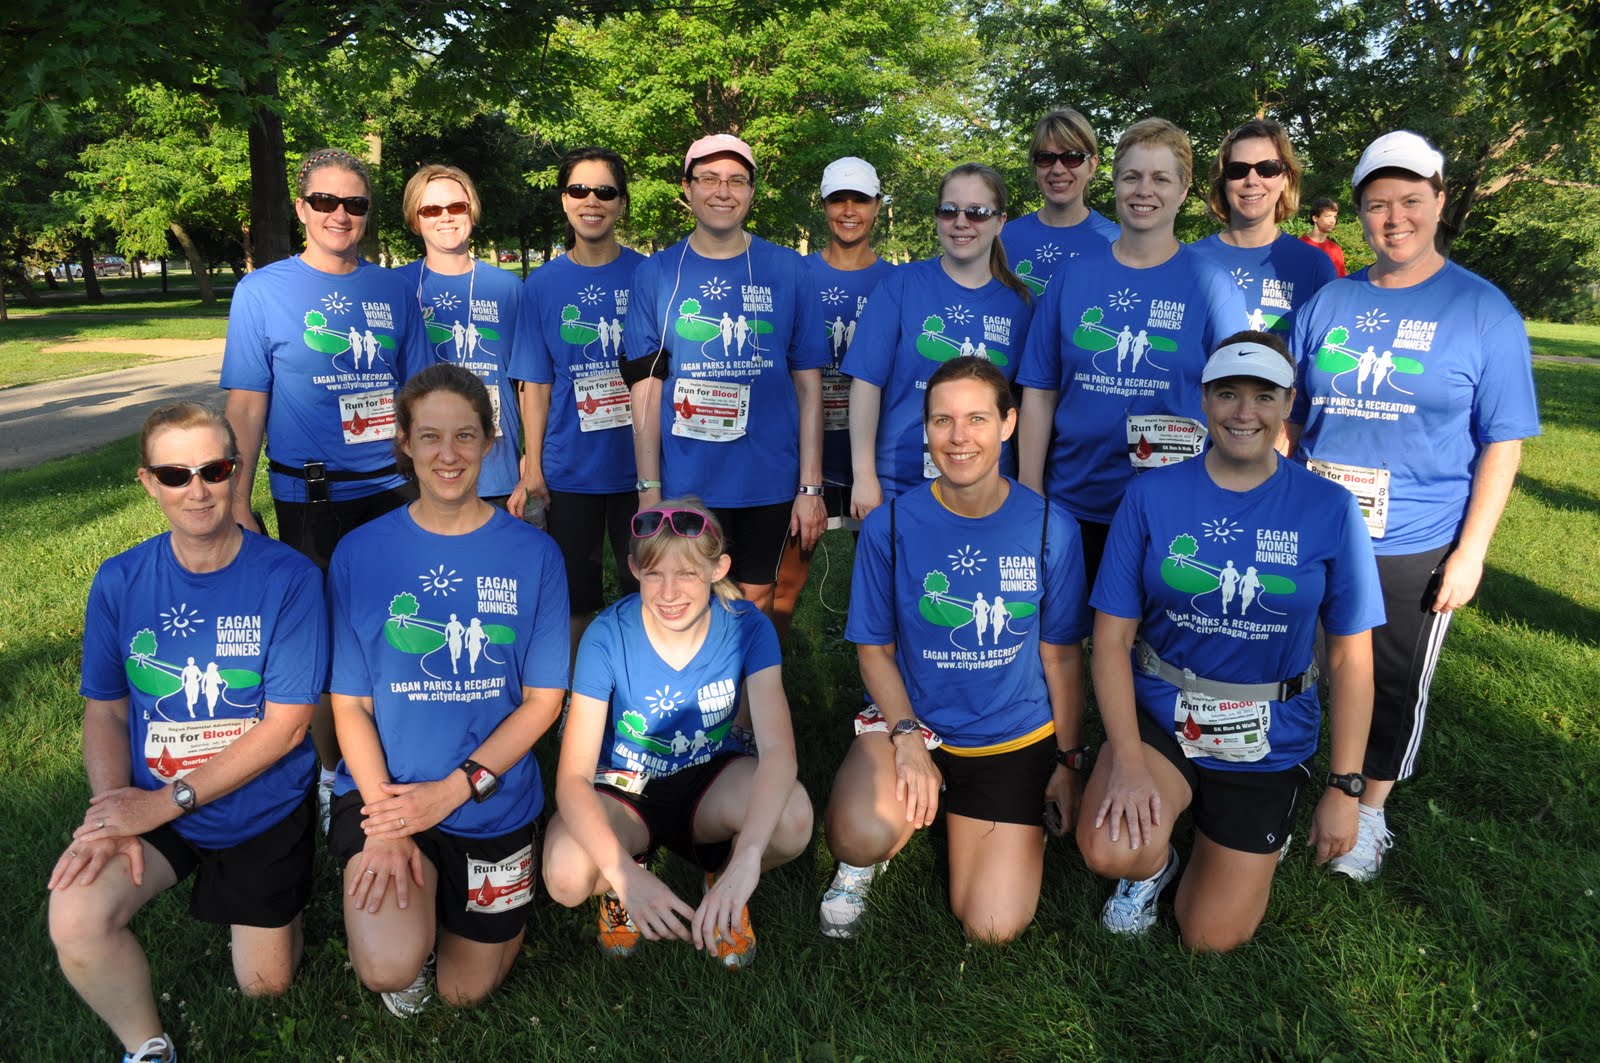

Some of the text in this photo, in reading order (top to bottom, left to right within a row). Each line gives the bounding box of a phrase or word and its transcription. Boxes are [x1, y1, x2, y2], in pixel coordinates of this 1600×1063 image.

[741, 285, 770, 295] EAGAN
[1262, 279, 1294, 291] EAGAN
[614, 289, 629, 298] EAG
[742, 294, 772, 304] WOMEN
[1262, 287, 1292, 300] WOMEN
[362, 302, 390, 312] EAGAN
[471, 300, 497, 308] EAGAN
[743, 303, 773, 312] RUNNERS
[1151, 300, 1185, 312] EAGAN
[1261, 297, 1292, 310] RUNNERS
[364, 310, 392, 320] WOMEN
[472, 307, 498, 315] WOMEN
[1150, 309, 1183, 320] WOMEN
[366, 319, 394, 330] RUNNERS
[472, 314, 499, 323] RUNNERS
[983, 315, 1012, 327] EAGAN
[1147, 318, 1182, 330] RUNNERS
[984, 323, 1010, 336] WOMEN
[1398, 319, 1437, 331] EAGAN
[984, 331, 1010, 346] RUNNERS
[1397, 329, 1434, 341] WOMEN
[1392, 339, 1432, 352] RUNNERS
[585, 362, 604, 370] PARKS
[681, 362, 700, 370] EAGAN
[703, 361, 724, 370] PARKS
[734, 360, 773, 368] RECREATION
[691, 368, 760, 378] www.cityofeagan.com
[313, 375, 336, 384] EAGAN
[916, 381, 927, 389] EAG
[1074, 372, 1170, 389] AGAN PARKS & RECREATION
[712, 390, 738, 398] Blood
[1082, 383, 1154, 397] www.cityofeagan.com
[1331, 397, 1355, 407] PARKS
[1358, 400, 1364, 408] &
[1365, 400, 1416, 413] RECREATION
[1168, 424, 1194, 433] Blood
[1311, 466, 1326, 476] Run
[1328, 471, 1341, 480] for
[1344, 474, 1374, 484] Blood
[1257, 529, 1298, 543] EAGAN
[1257, 540, 1298, 554] WOMEN
[1000, 556, 1036, 568] EAGAN
[1256, 551, 1297, 566] RUNNERS
[1000, 568, 1036, 580] WOMEN
[477, 576, 517, 591] EAGAN
[1001, 580, 1037, 591] RUNNERS
[478, 589, 517, 603] WOMEN
[478, 601, 518, 615] RUNNERS
[217, 616, 261, 629] EAGAN
[1192, 614, 1219, 626] PARKS
[1232, 619, 1287, 632] RECREATION
[217, 629, 260, 643] WOMEN
[1177, 621, 1269, 640] www.cityofeagan.com
[216, 643, 260, 657] RUNNERS
[923, 641, 1024, 660] EAGAN PARKS & RECREAT
[391, 677, 506, 692] EAGAN PARKS & RECREATI
[697, 678, 735, 700] EAGAN
[408, 689, 500, 702] www.cityofeagan.com
[698, 692, 736, 714] WOMEN
[152, 728, 242, 743] Run for Blood
[615, 743, 640, 760] EAGAN
[641, 752, 668, 771] PARKS
[474, 865, 496, 874] Run
